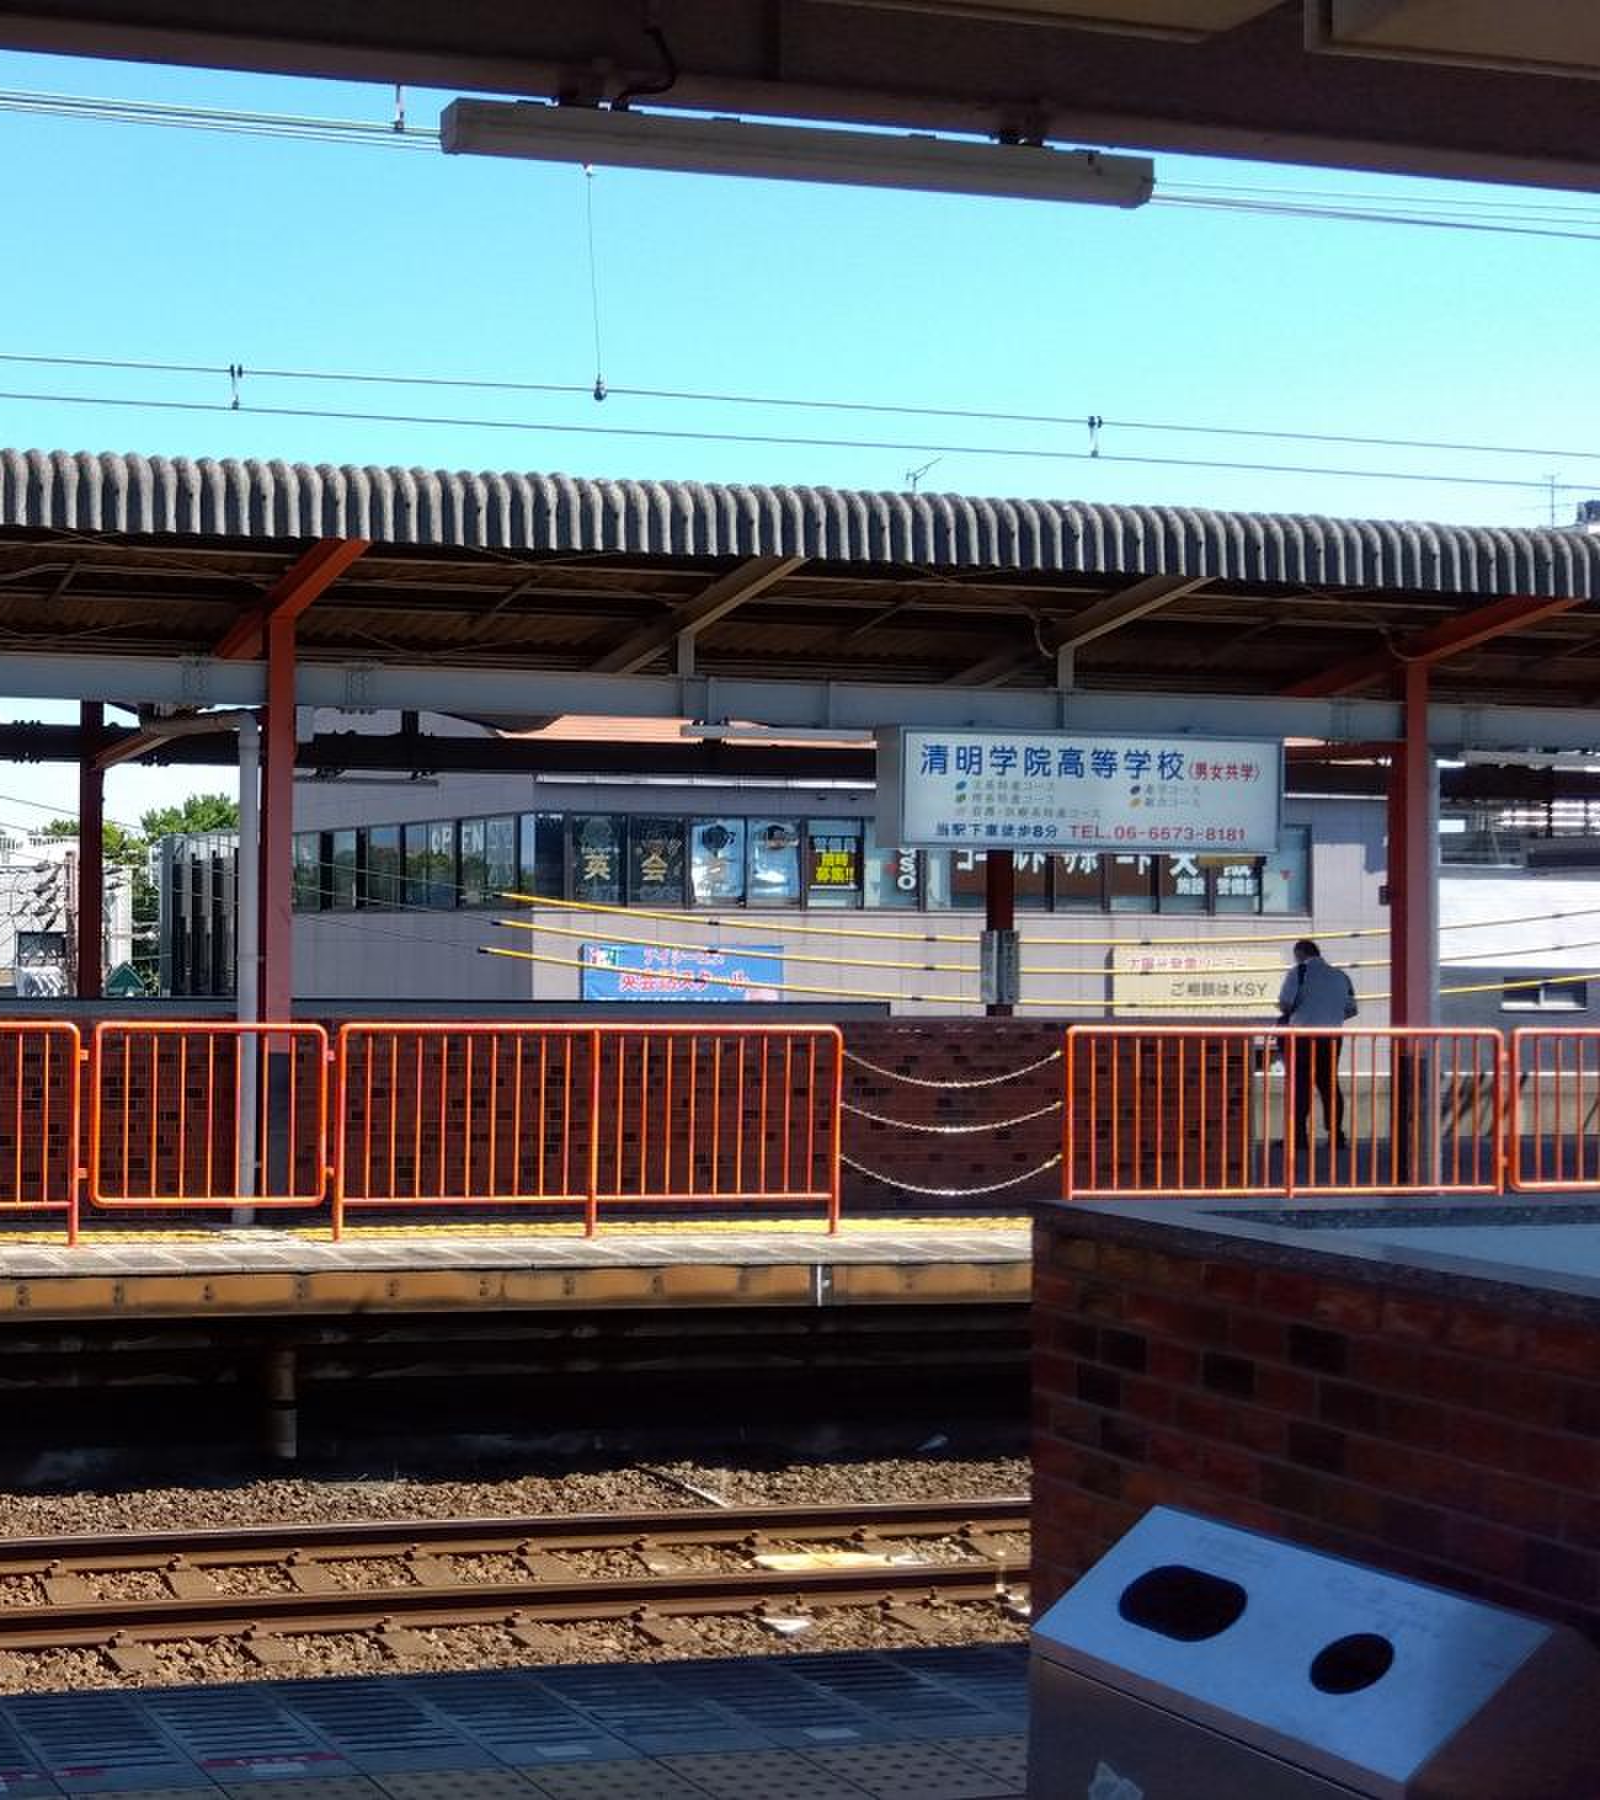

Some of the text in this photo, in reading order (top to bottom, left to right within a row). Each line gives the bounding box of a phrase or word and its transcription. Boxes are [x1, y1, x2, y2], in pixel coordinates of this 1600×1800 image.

[919, 743, 1186, 780] 清明学院高等学校
